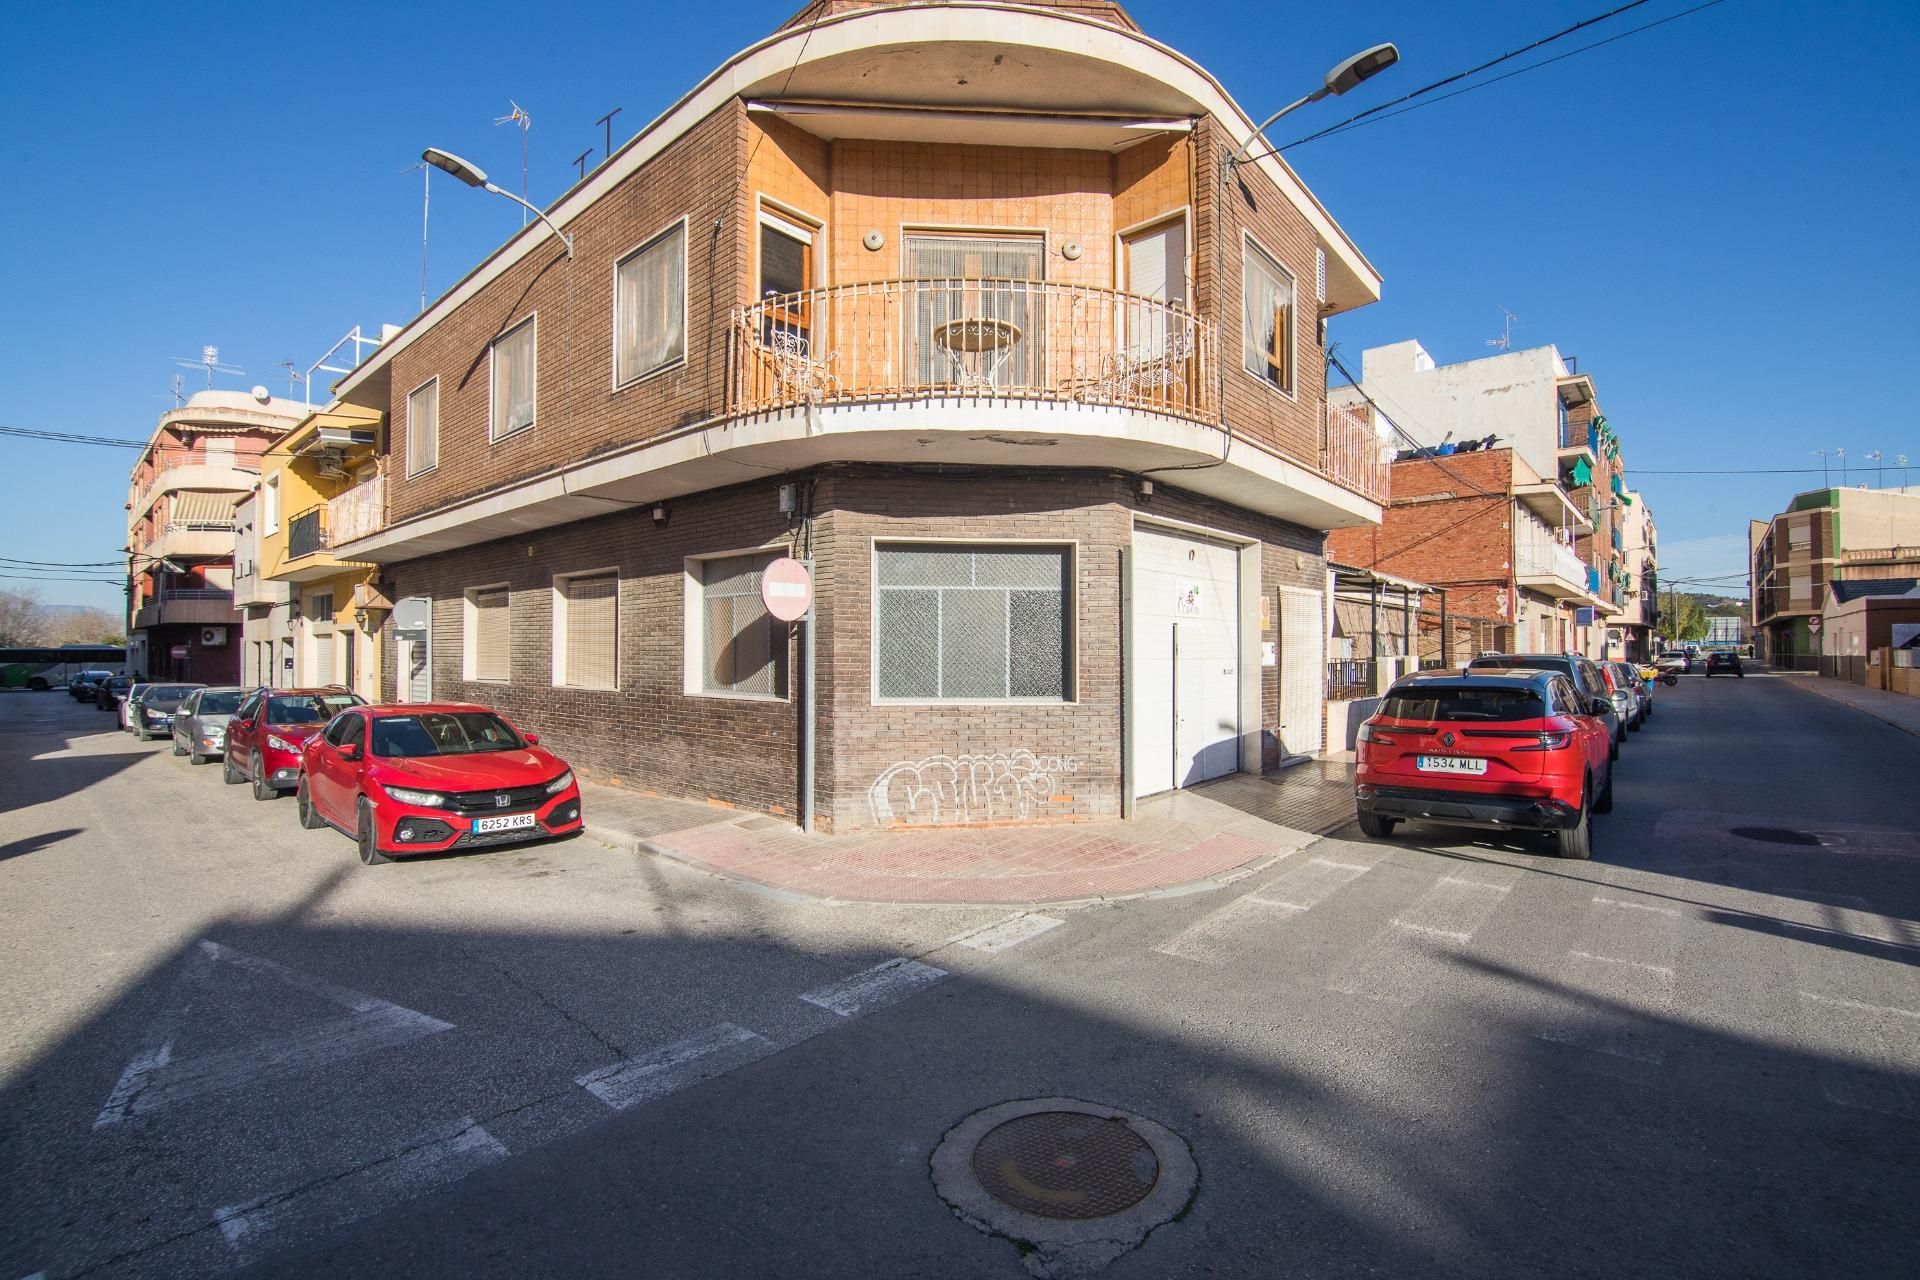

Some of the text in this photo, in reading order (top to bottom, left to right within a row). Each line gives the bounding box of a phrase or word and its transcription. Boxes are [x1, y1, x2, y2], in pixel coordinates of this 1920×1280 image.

[1428, 757, 1455, 768] 1534
[1459, 759, 1483, 771] MLL
[481, 815, 532, 830] 6252 KRS
